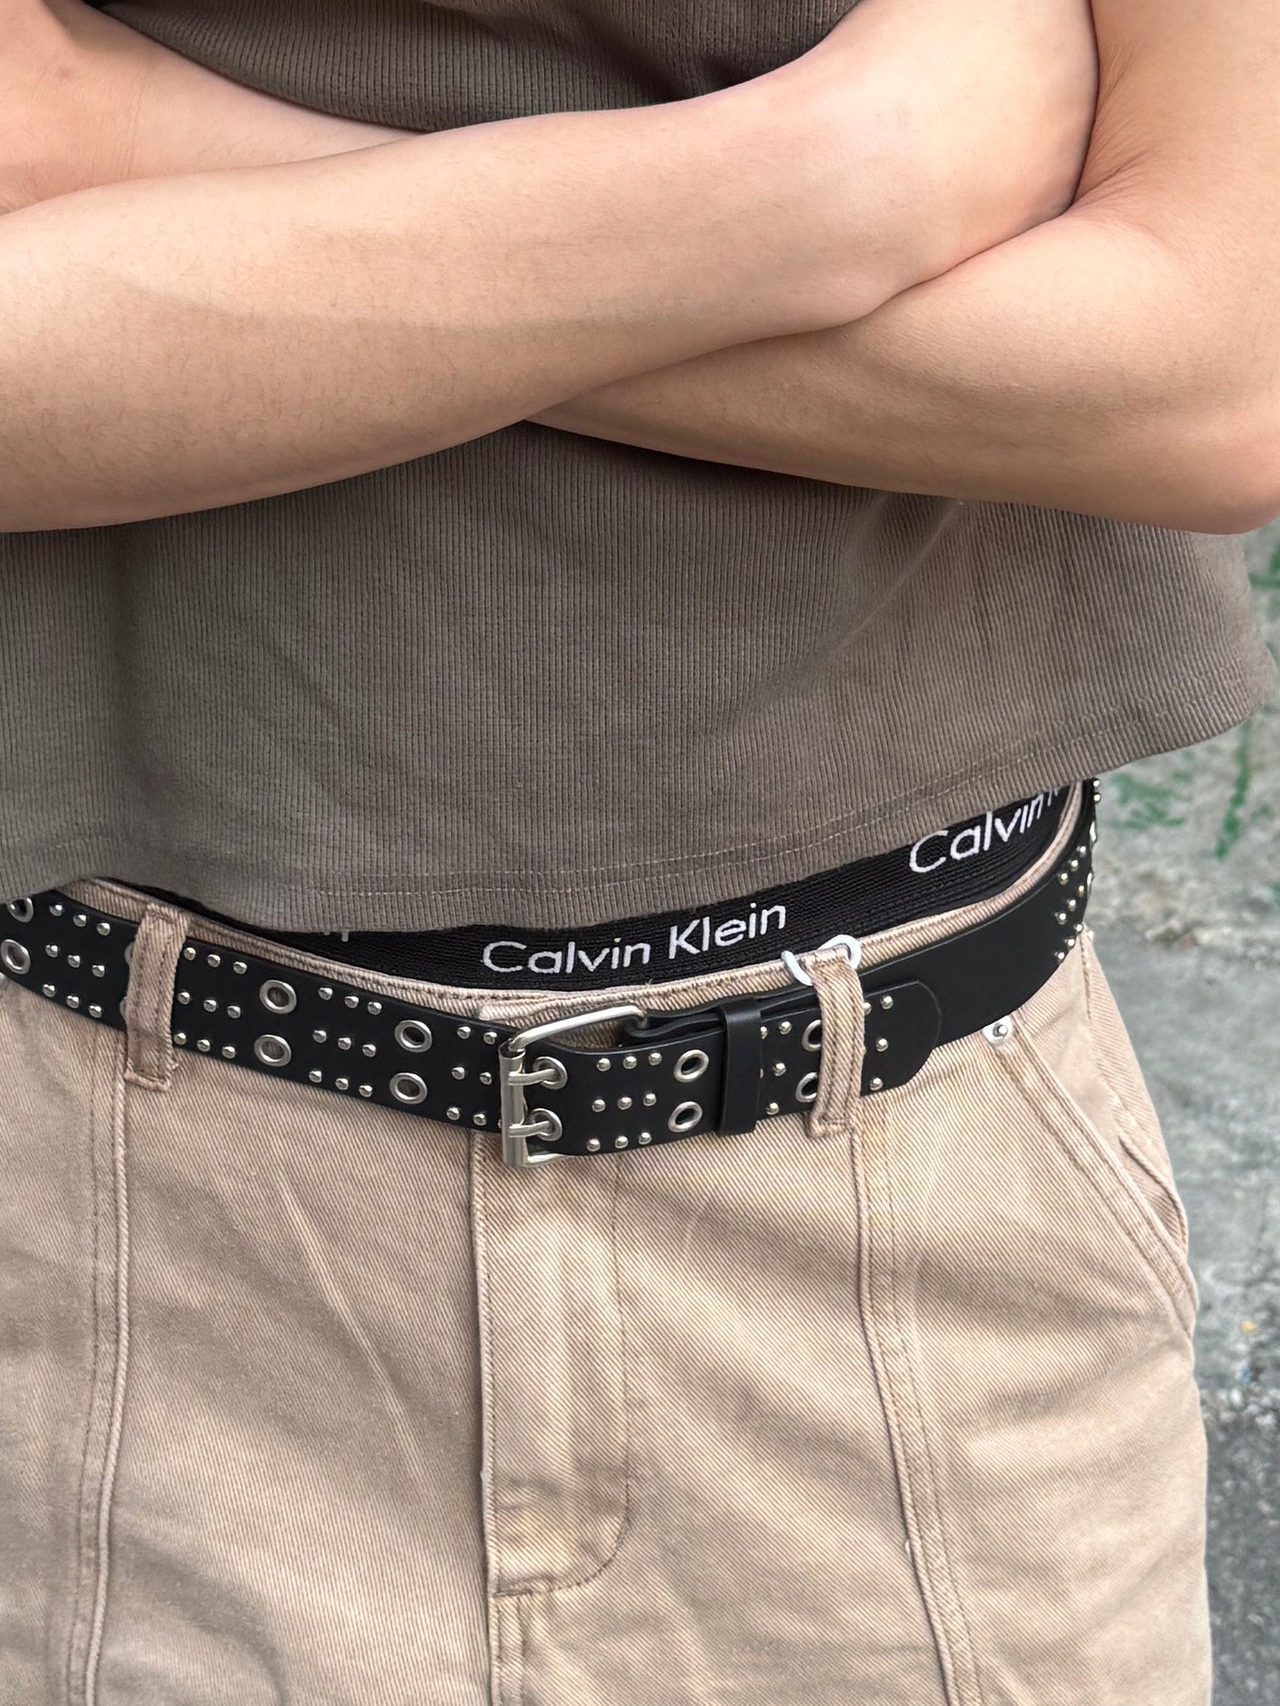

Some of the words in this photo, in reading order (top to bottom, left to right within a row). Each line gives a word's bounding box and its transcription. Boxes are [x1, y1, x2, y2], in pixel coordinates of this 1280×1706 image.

[909, 792, 1044, 874] Calvin
[481, 937, 651, 974] Calvin
[669, 903, 786, 960] Klein
